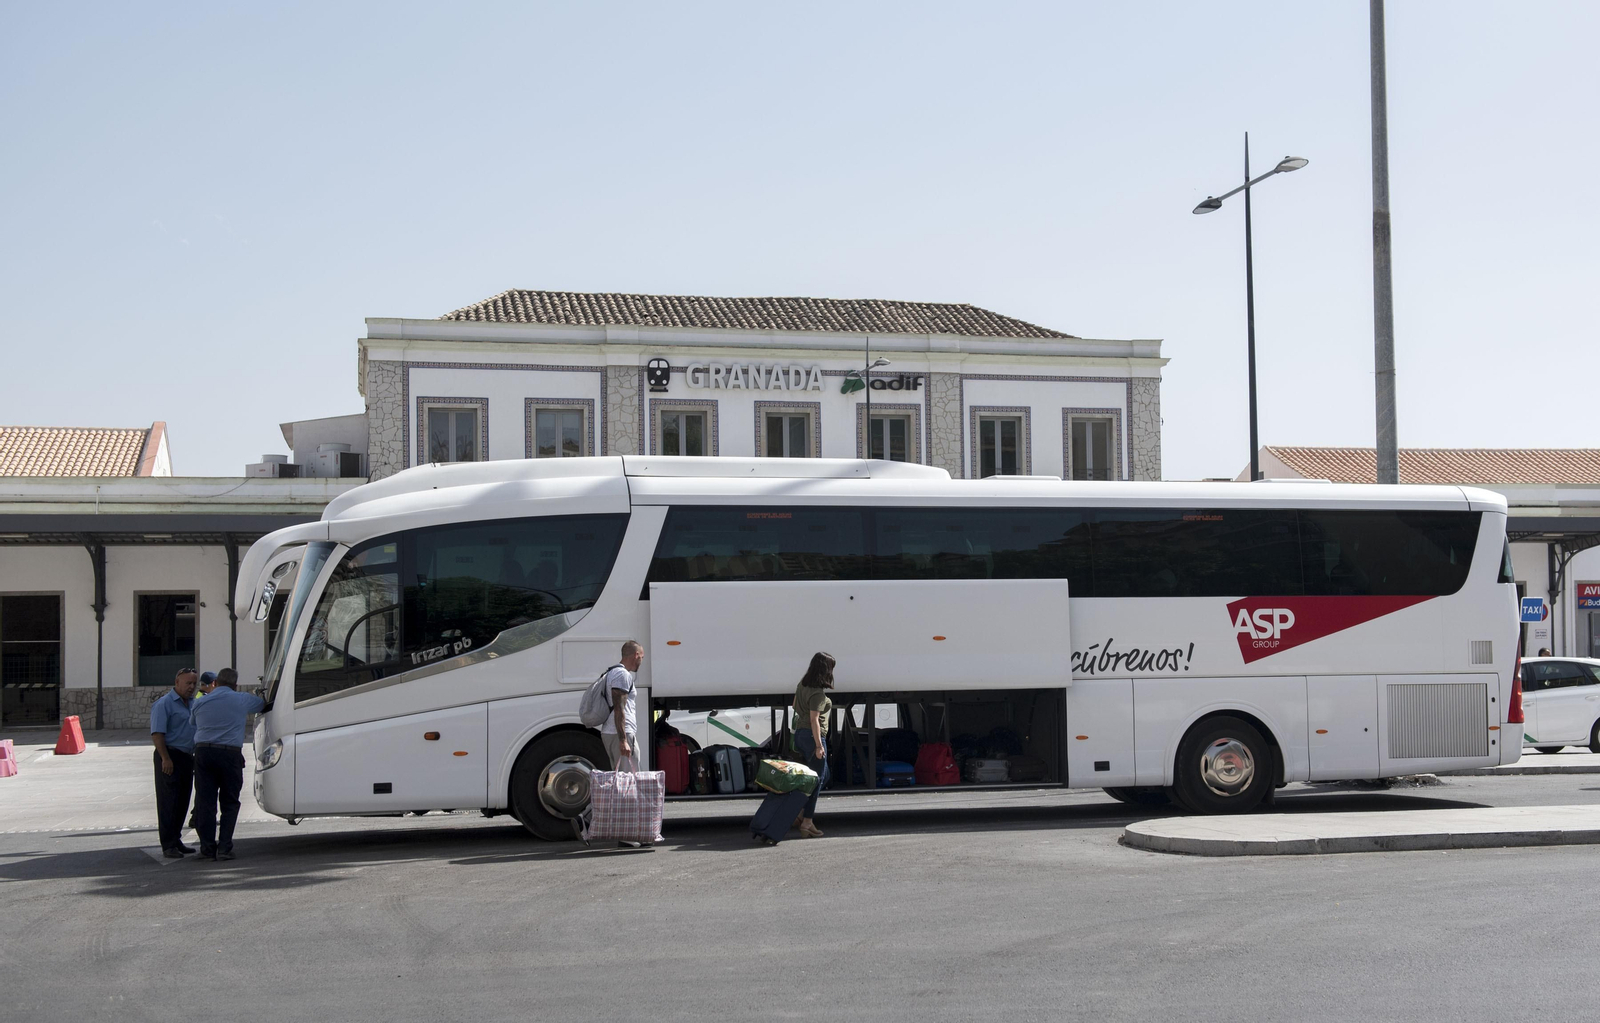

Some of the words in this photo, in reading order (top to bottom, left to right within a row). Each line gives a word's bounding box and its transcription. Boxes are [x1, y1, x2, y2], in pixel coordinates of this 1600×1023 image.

[685, 362, 825, 391] GRANADA
[869, 374, 924, 391] adif
[1522, 606, 1542, 614] TAXI
[1233, 608, 1295, 639] ASP
[453, 636, 472, 655] pb
[1252, 640, 1280, 649] GROUP
